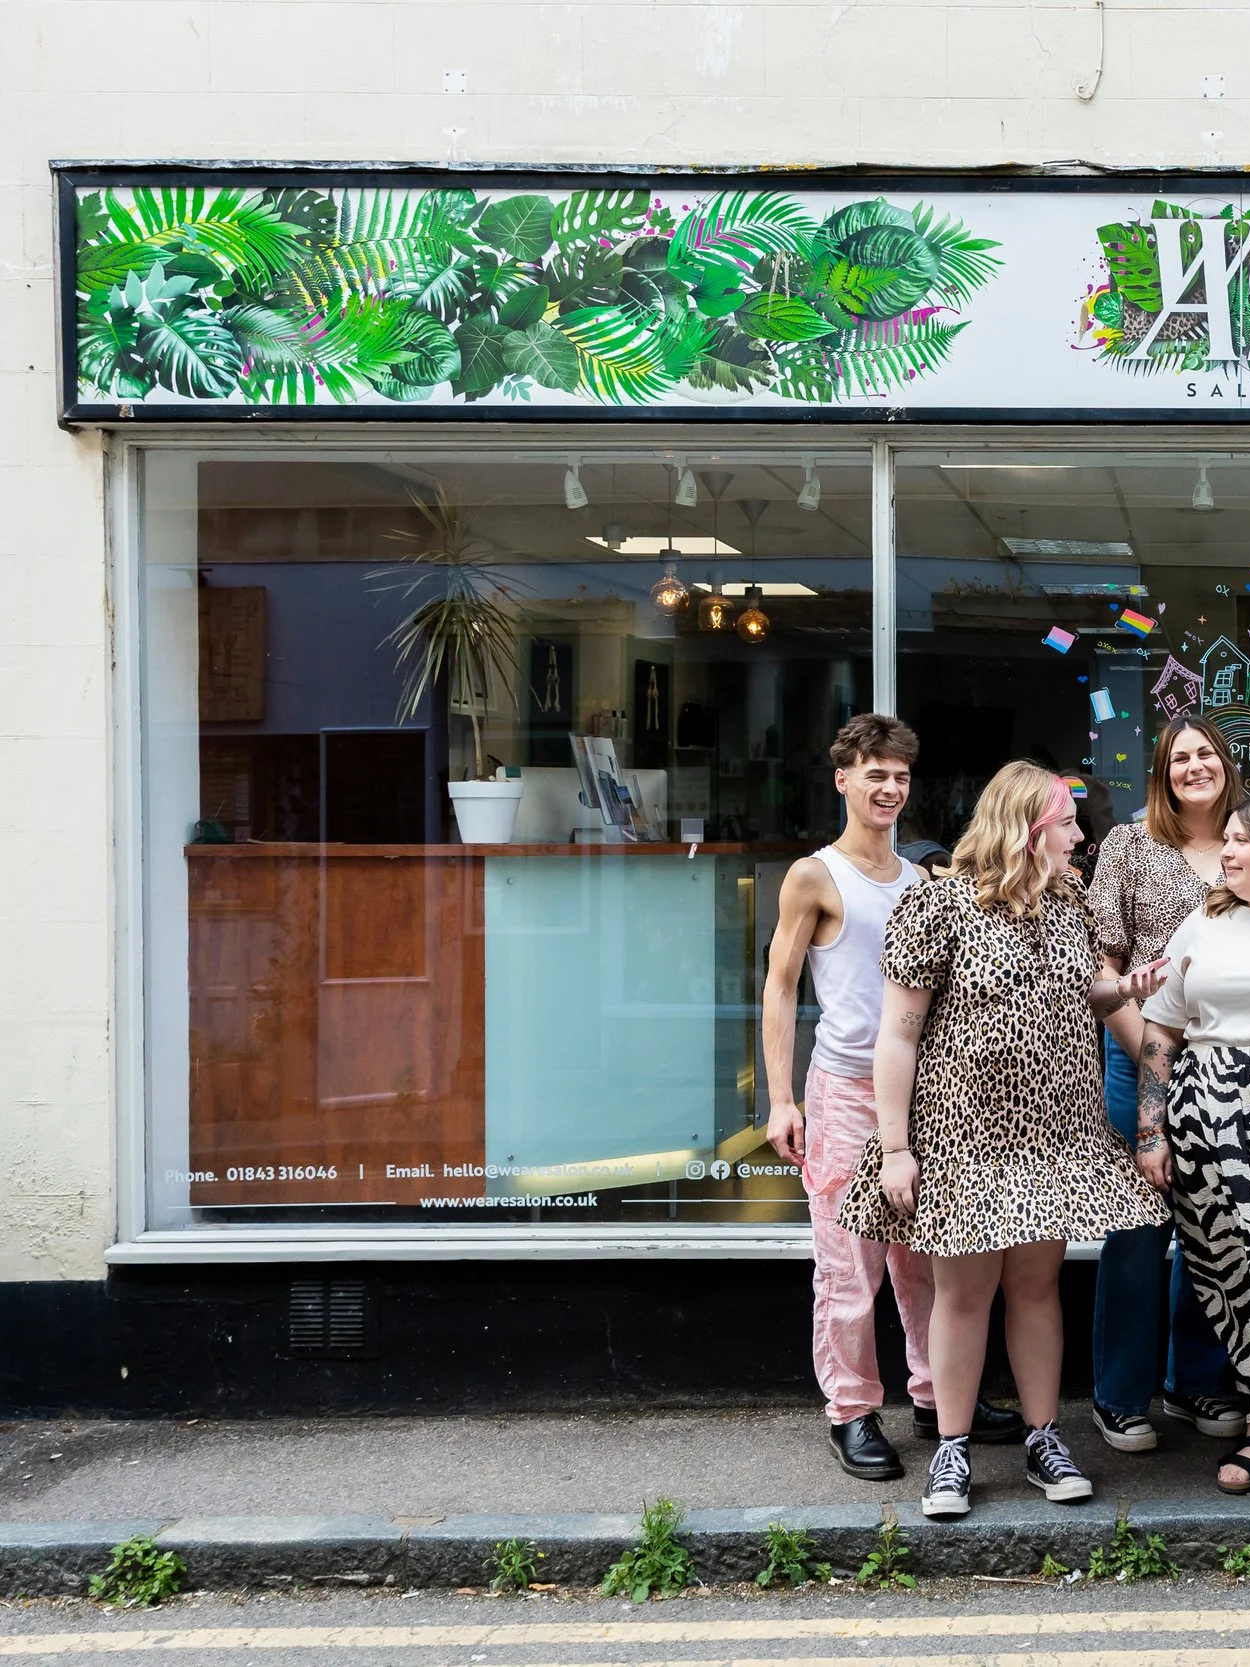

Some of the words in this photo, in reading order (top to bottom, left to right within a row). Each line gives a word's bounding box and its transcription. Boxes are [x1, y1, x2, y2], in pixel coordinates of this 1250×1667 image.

[165, 1169, 219, 1182] Phone.
[226, 1166, 275, 1181] 01843
[278, 1165, 338, 1180] 316046
[386, 1164, 435, 1178] Email.
[419, 1192, 598, 1209] www.wearesalon.co.uk
